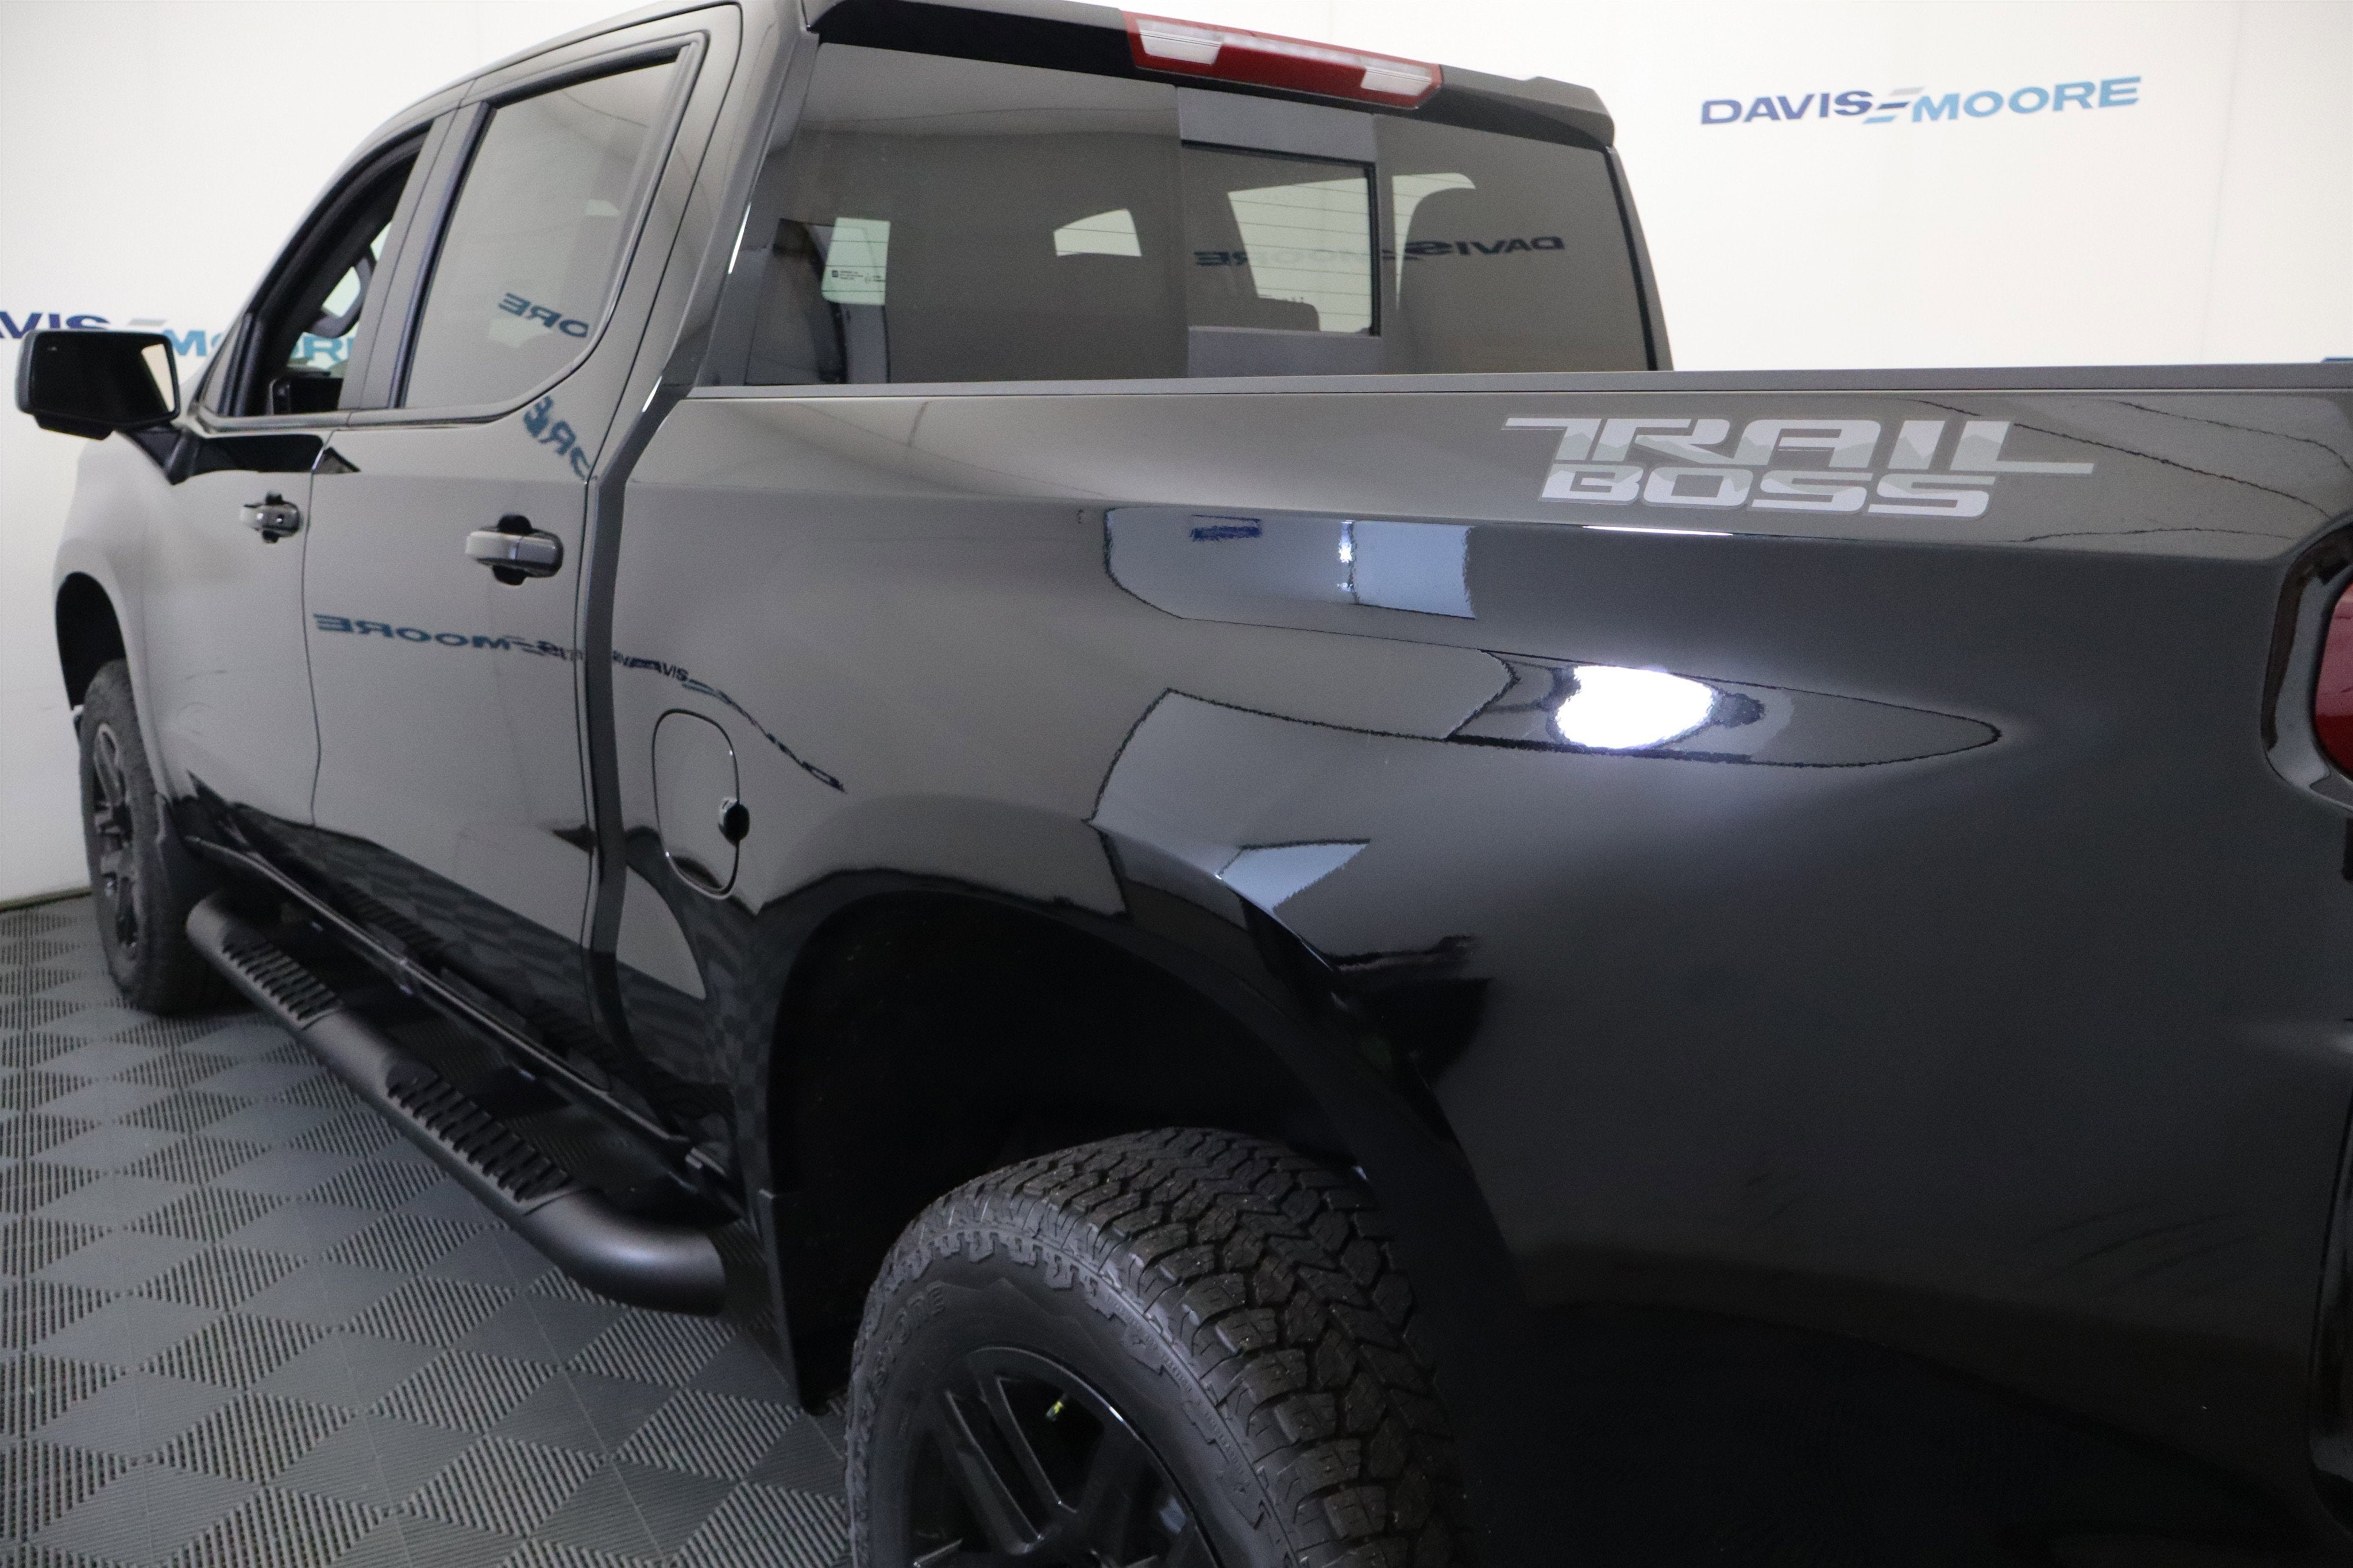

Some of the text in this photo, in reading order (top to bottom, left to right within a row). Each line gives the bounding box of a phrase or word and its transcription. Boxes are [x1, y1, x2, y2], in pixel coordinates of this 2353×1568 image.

[1700, 76, 2142, 125] DAVIS MOORE
[0, 311, 110, 339] VIS
[1501, 417, 2094, 474] TRAIL
[1538, 462, 1997, 519] BOSS
